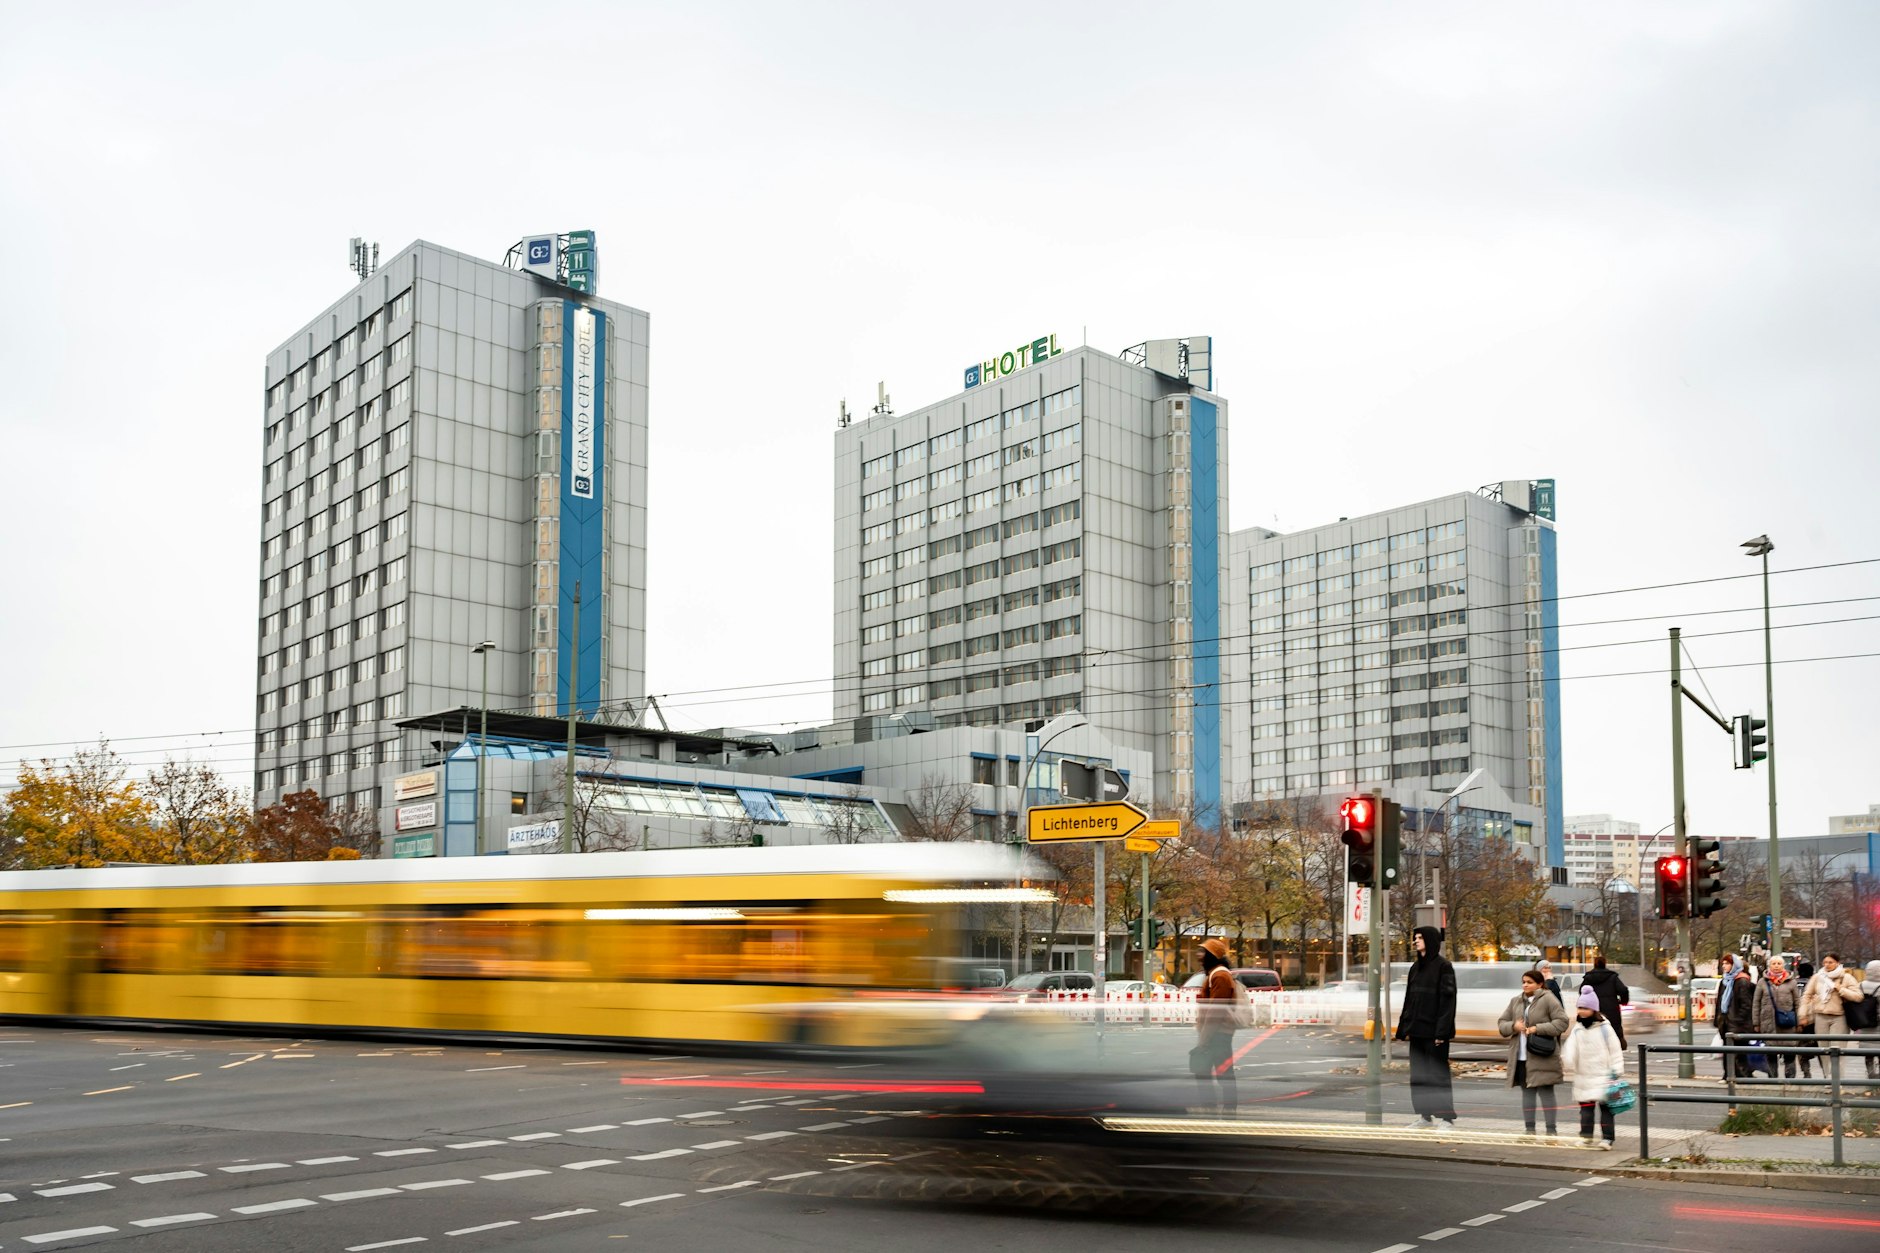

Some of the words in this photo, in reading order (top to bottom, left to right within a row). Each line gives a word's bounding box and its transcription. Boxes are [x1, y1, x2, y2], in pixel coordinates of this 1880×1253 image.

[983, 334, 1063, 383] HOTEL
[577, 372, 590, 409] CITY
[577, 411, 590, 472] GRAND
[1043, 816, 1118, 831] Lichtenberg
